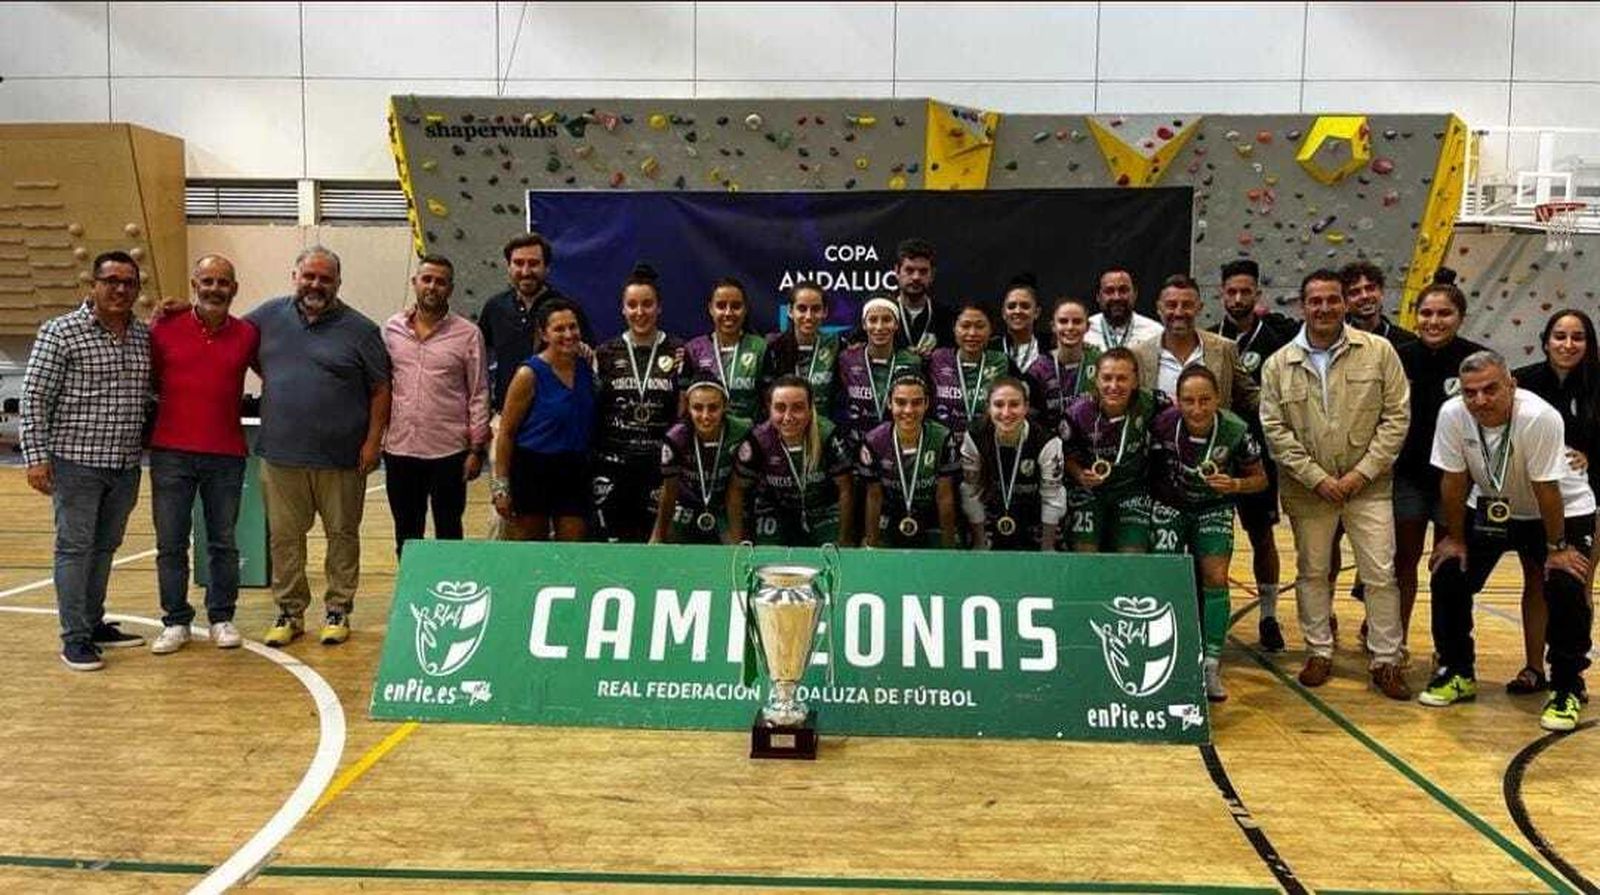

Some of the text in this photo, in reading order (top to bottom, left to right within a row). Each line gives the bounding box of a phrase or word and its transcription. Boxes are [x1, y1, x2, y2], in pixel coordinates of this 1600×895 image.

[824, 244, 878, 262] COPA
[755, 516, 778, 535] 10
[1073, 511, 1094, 532] 25
[1156, 528, 1178, 550] 20
[383, 678, 457, 705] enPie.es
[597, 680, 641, 697] REAL
[874, 687, 898, 705] DE
[904, 685, 977, 707] FÚTBOL
[1087, 702, 1167, 729] enPie.es
